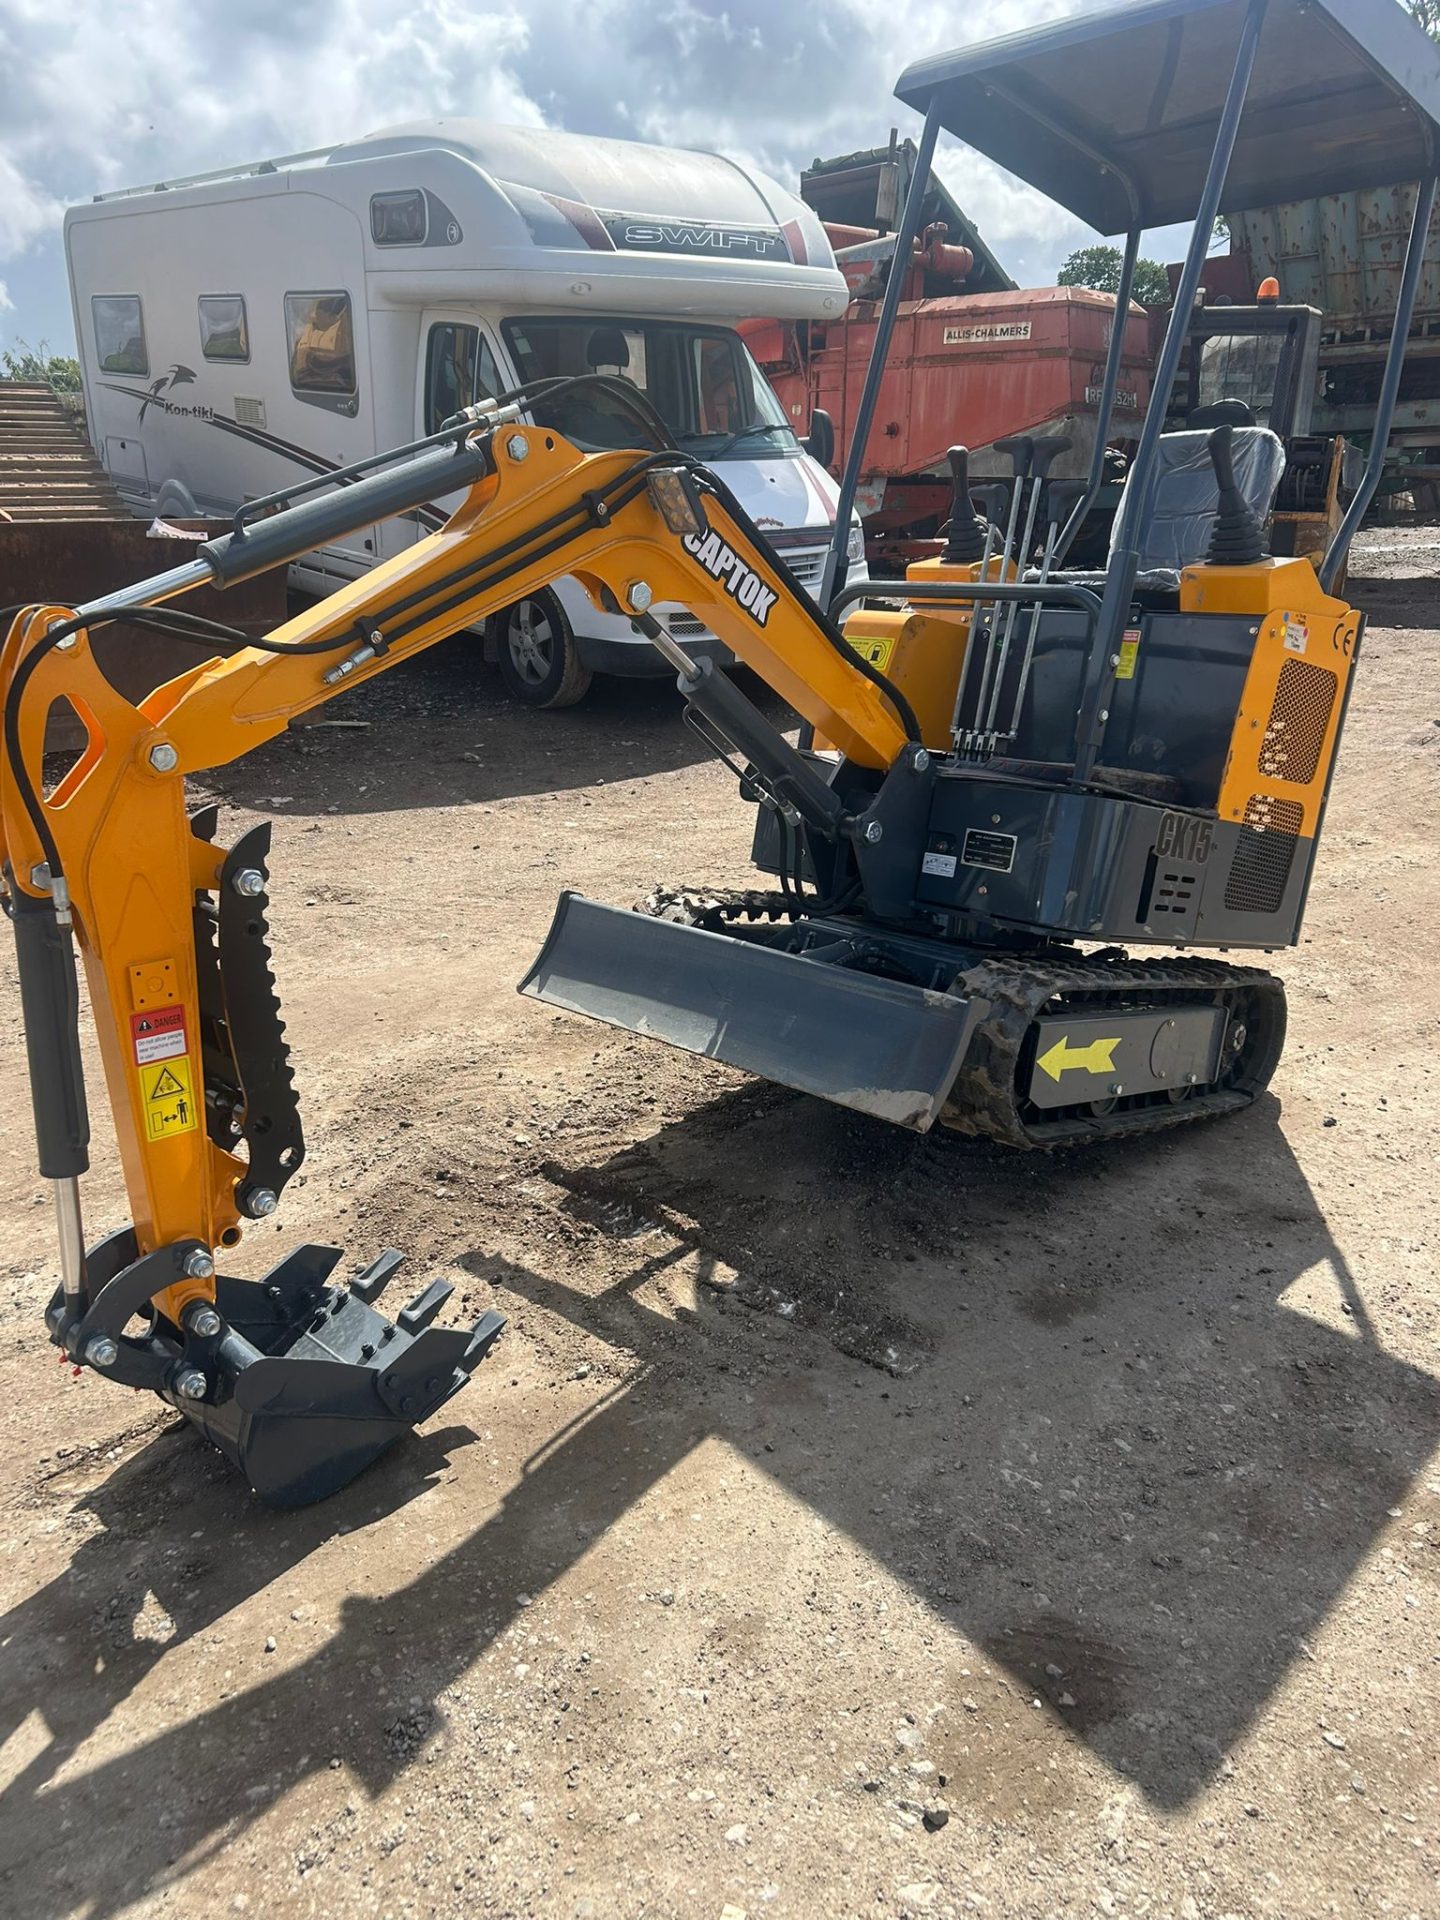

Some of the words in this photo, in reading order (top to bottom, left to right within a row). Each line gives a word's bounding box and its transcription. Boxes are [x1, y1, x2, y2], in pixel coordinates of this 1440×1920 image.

[625, 225, 775, 253] SWIFT
[165, 402, 213, 419] Kon-tiki
[684, 526, 777, 624] CAPTOK
[1155, 811, 1214, 864] CK15
[154, 1013, 181, 1029] DANGER
